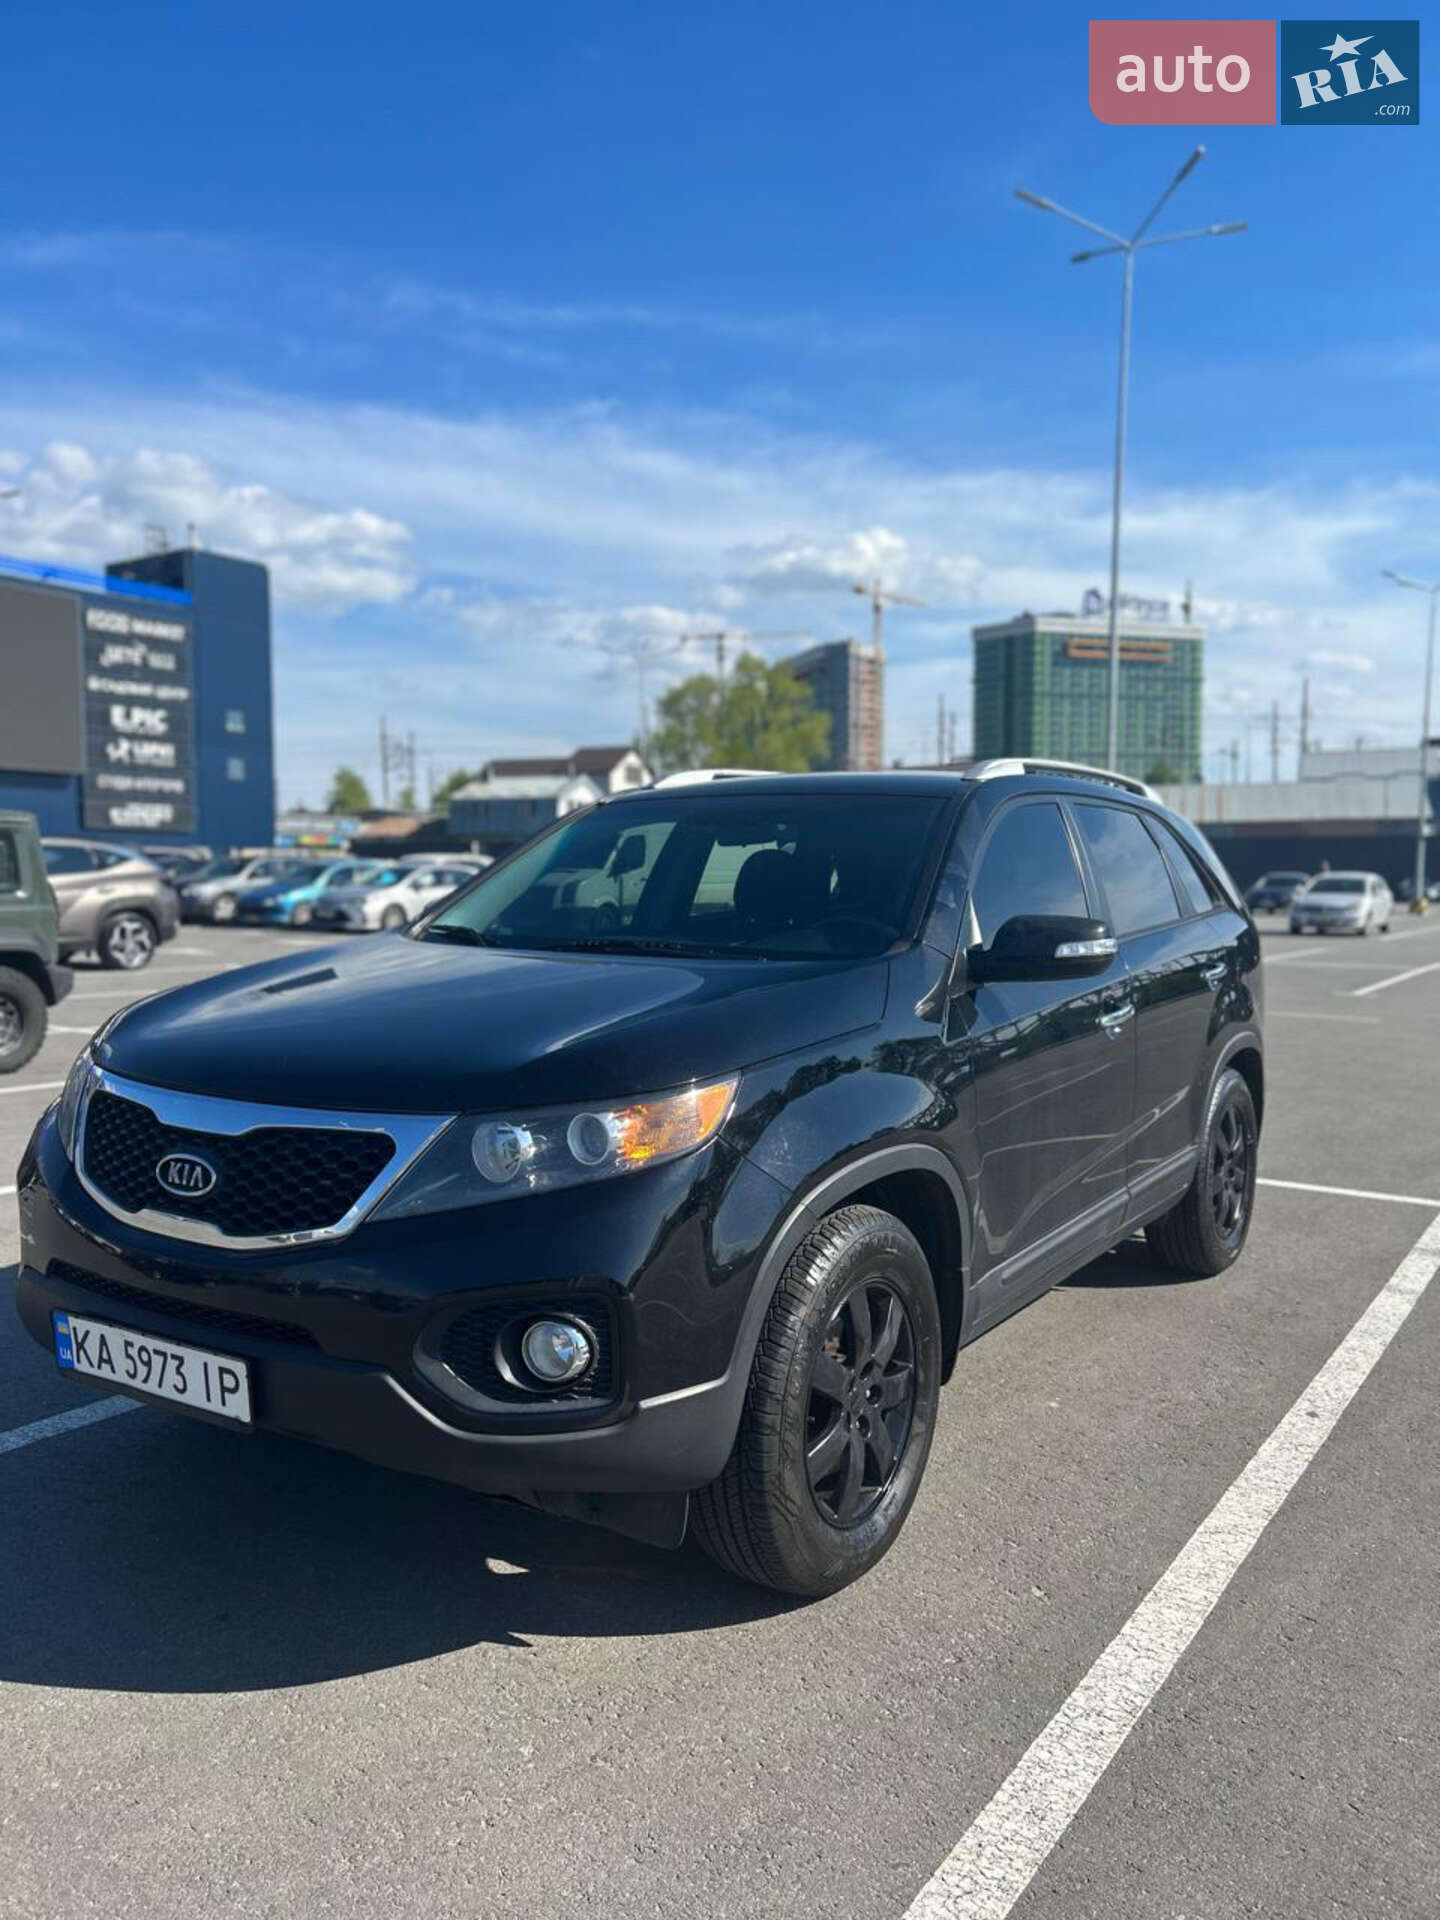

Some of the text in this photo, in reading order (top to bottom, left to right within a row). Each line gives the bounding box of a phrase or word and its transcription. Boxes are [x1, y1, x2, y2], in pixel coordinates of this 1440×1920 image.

[168, 1161, 203, 1188] KIA
[61, 1347, 72, 1361] UA
[72, 1326, 241, 1407] KA 5973 IP
